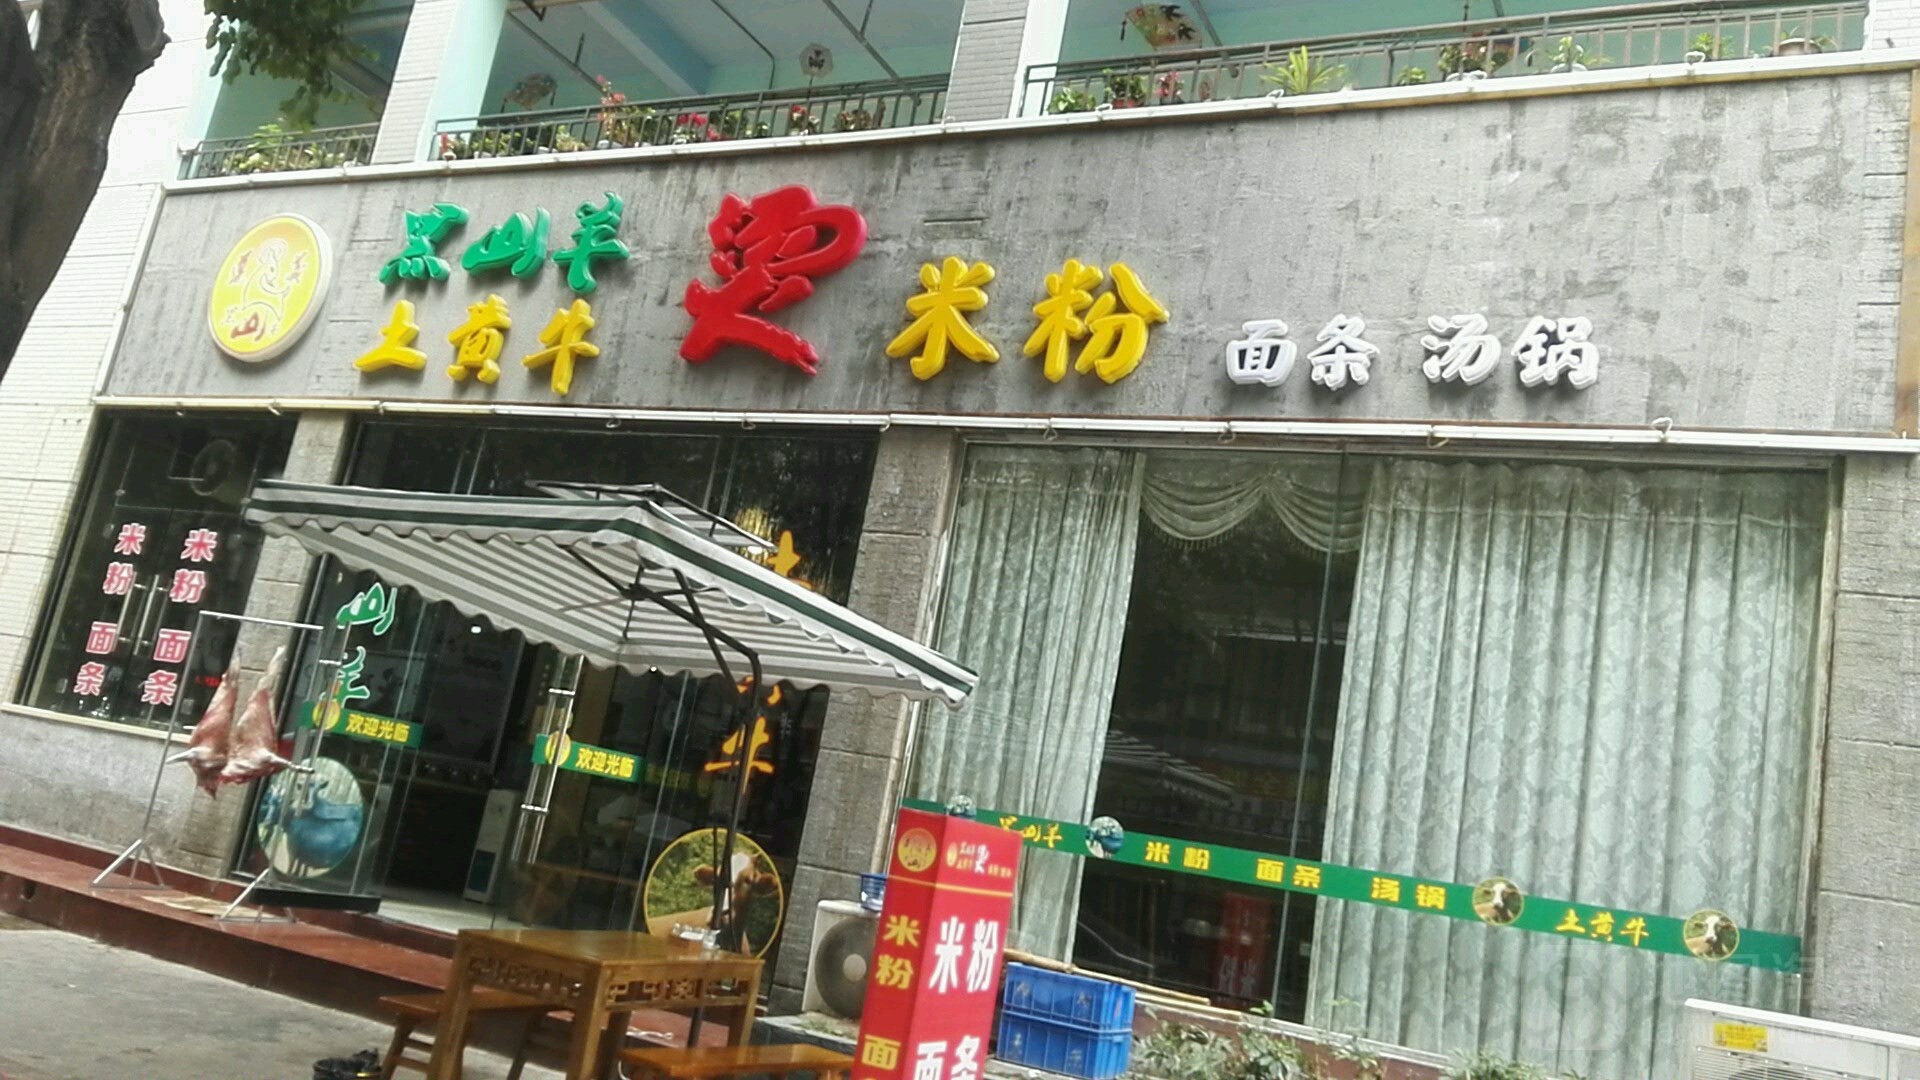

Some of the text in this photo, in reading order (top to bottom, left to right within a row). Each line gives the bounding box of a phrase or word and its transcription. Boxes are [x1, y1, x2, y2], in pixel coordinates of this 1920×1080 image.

[354, 294, 601, 395] 土黄牛
[886, 256, 1169, 383] 米粉
[1226, 313, 1599, 391] 面条 汤锅
[73, 522, 146, 696] 米粉 面条
[141, 528, 218, 706] 米粉 面条
[346, 713, 410, 743] 欢迎光临
[575, 747, 635, 779] 欢迎光临
[1145, 841, 1210, 870] 米粉
[1256, 858, 1321, 889] 面条
[1370, 876, 1446, 910] 汤锅
[1556, 909, 1649, 947] 土黄牛
[857, 915, 920, 1080] 米粉 面
[928, 916, 999, 993] 米粉
